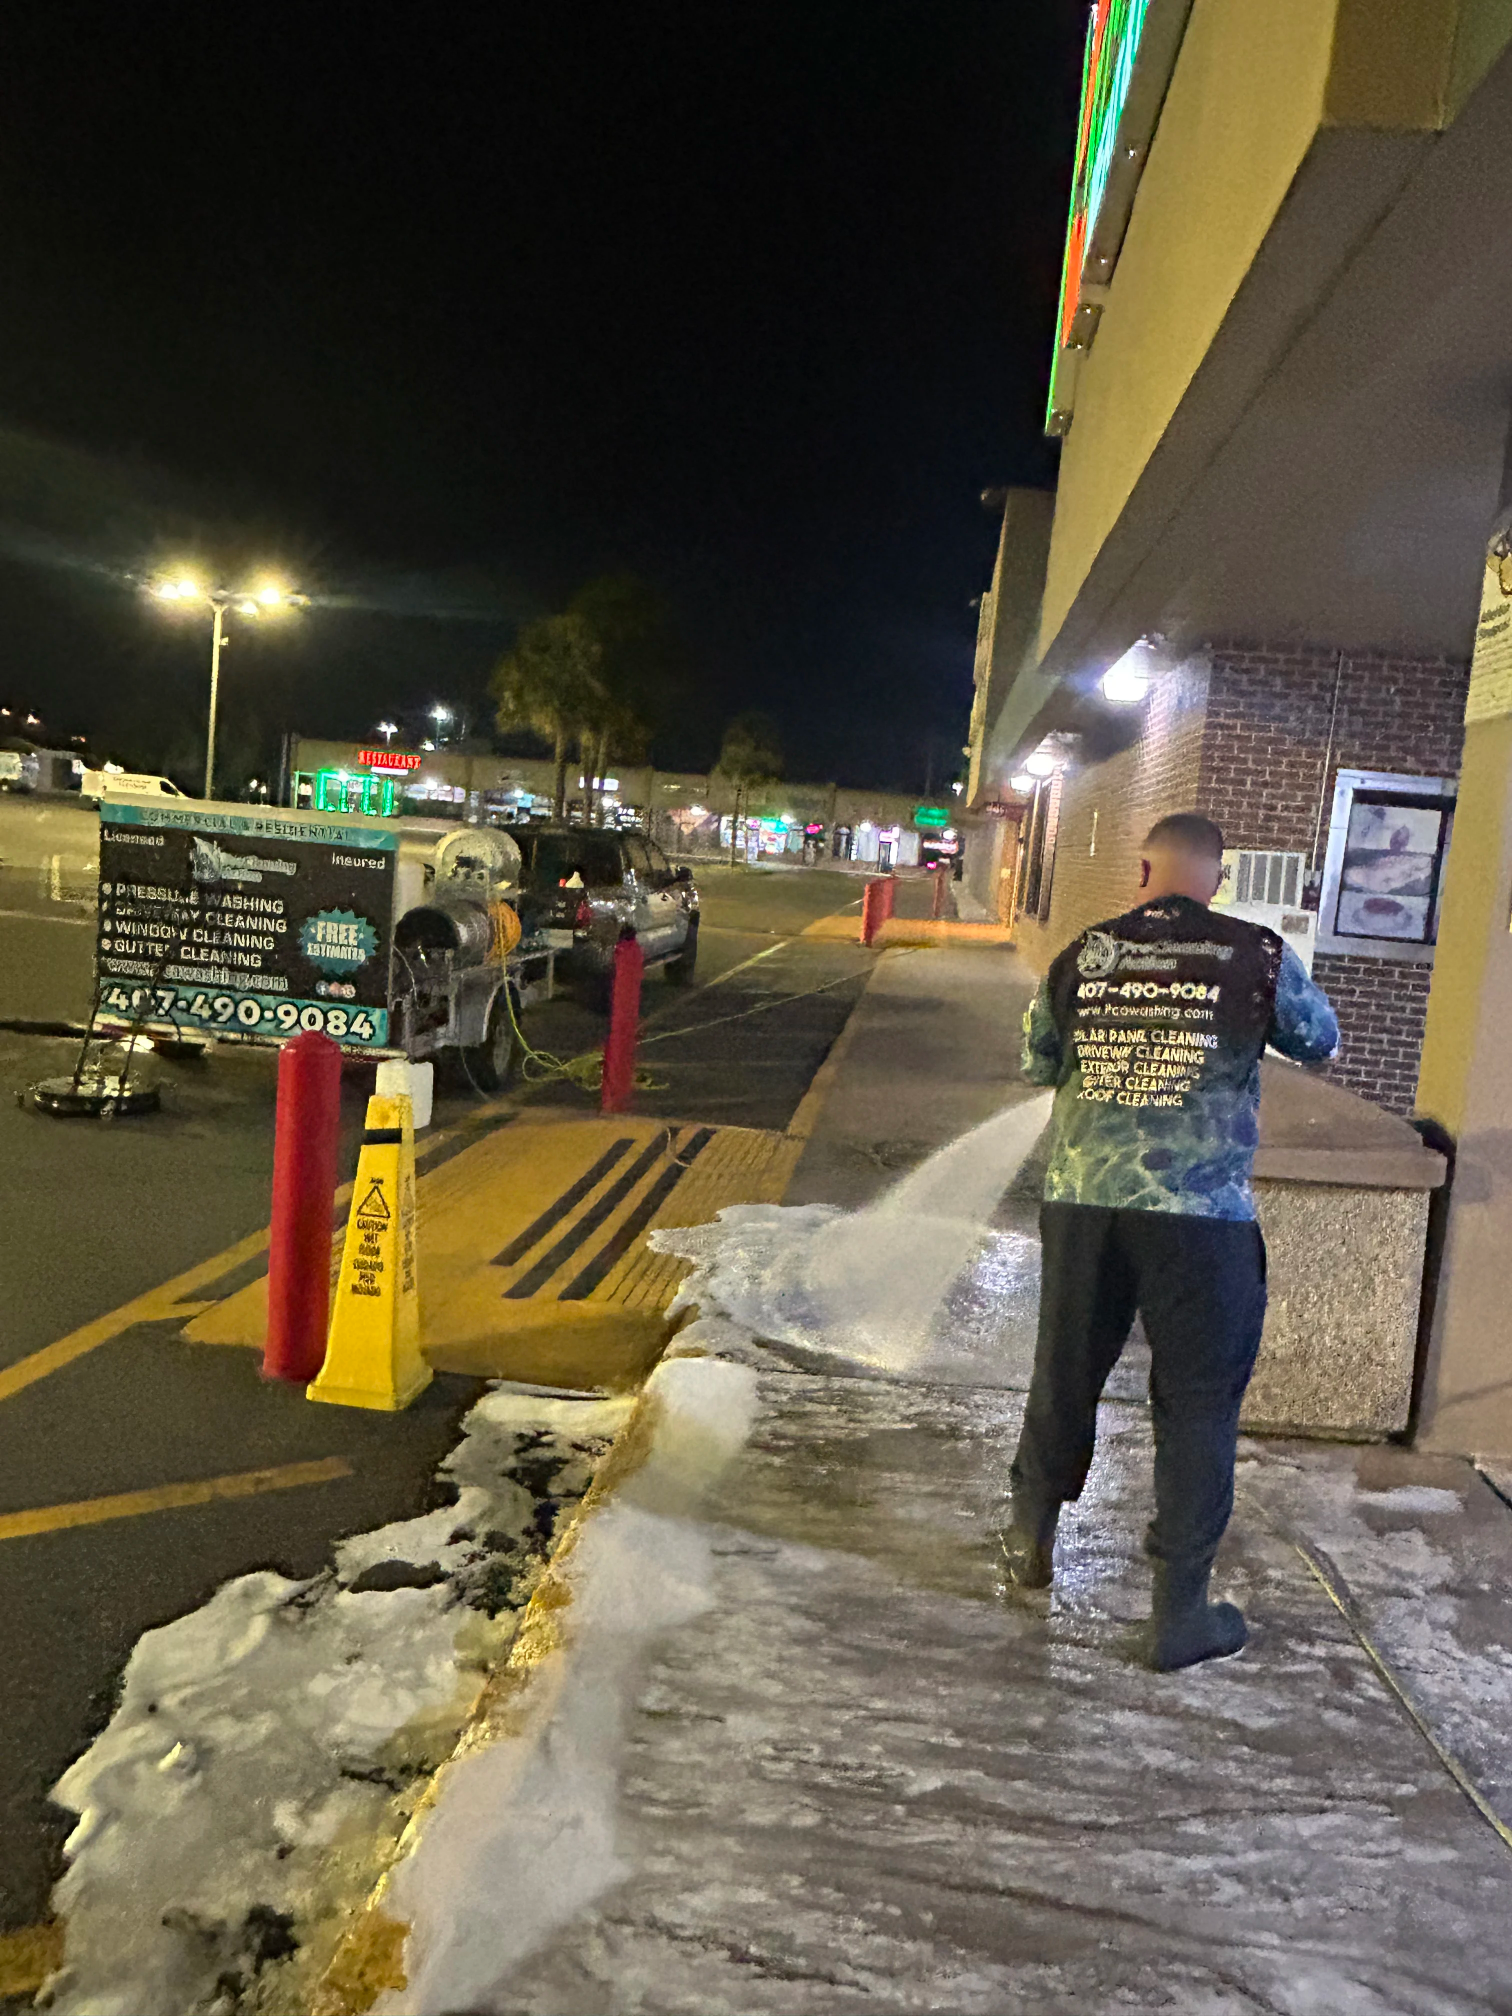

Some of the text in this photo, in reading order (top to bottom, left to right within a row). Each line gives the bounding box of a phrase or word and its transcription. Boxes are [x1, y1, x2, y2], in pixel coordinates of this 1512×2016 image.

[331, 851, 385, 870] Insured
[205, 911, 288, 934] CLEANING
[192, 927, 276, 951] CLEANING
[316, 921, 359, 947] FREE
[180, 945, 262, 969] CLEANING
[1076, 980, 1221, 1003] 407-490-9084
[1150, 1030, 1219, 1050] CLEANING
[1135, 1045, 1206, 1065] CLEANING
[1133, 1061, 1201, 1080] CLEANING
[1124, 1077, 1191, 1093] CLEANING
[1116, 1091, 1184, 1108] CLEANING
